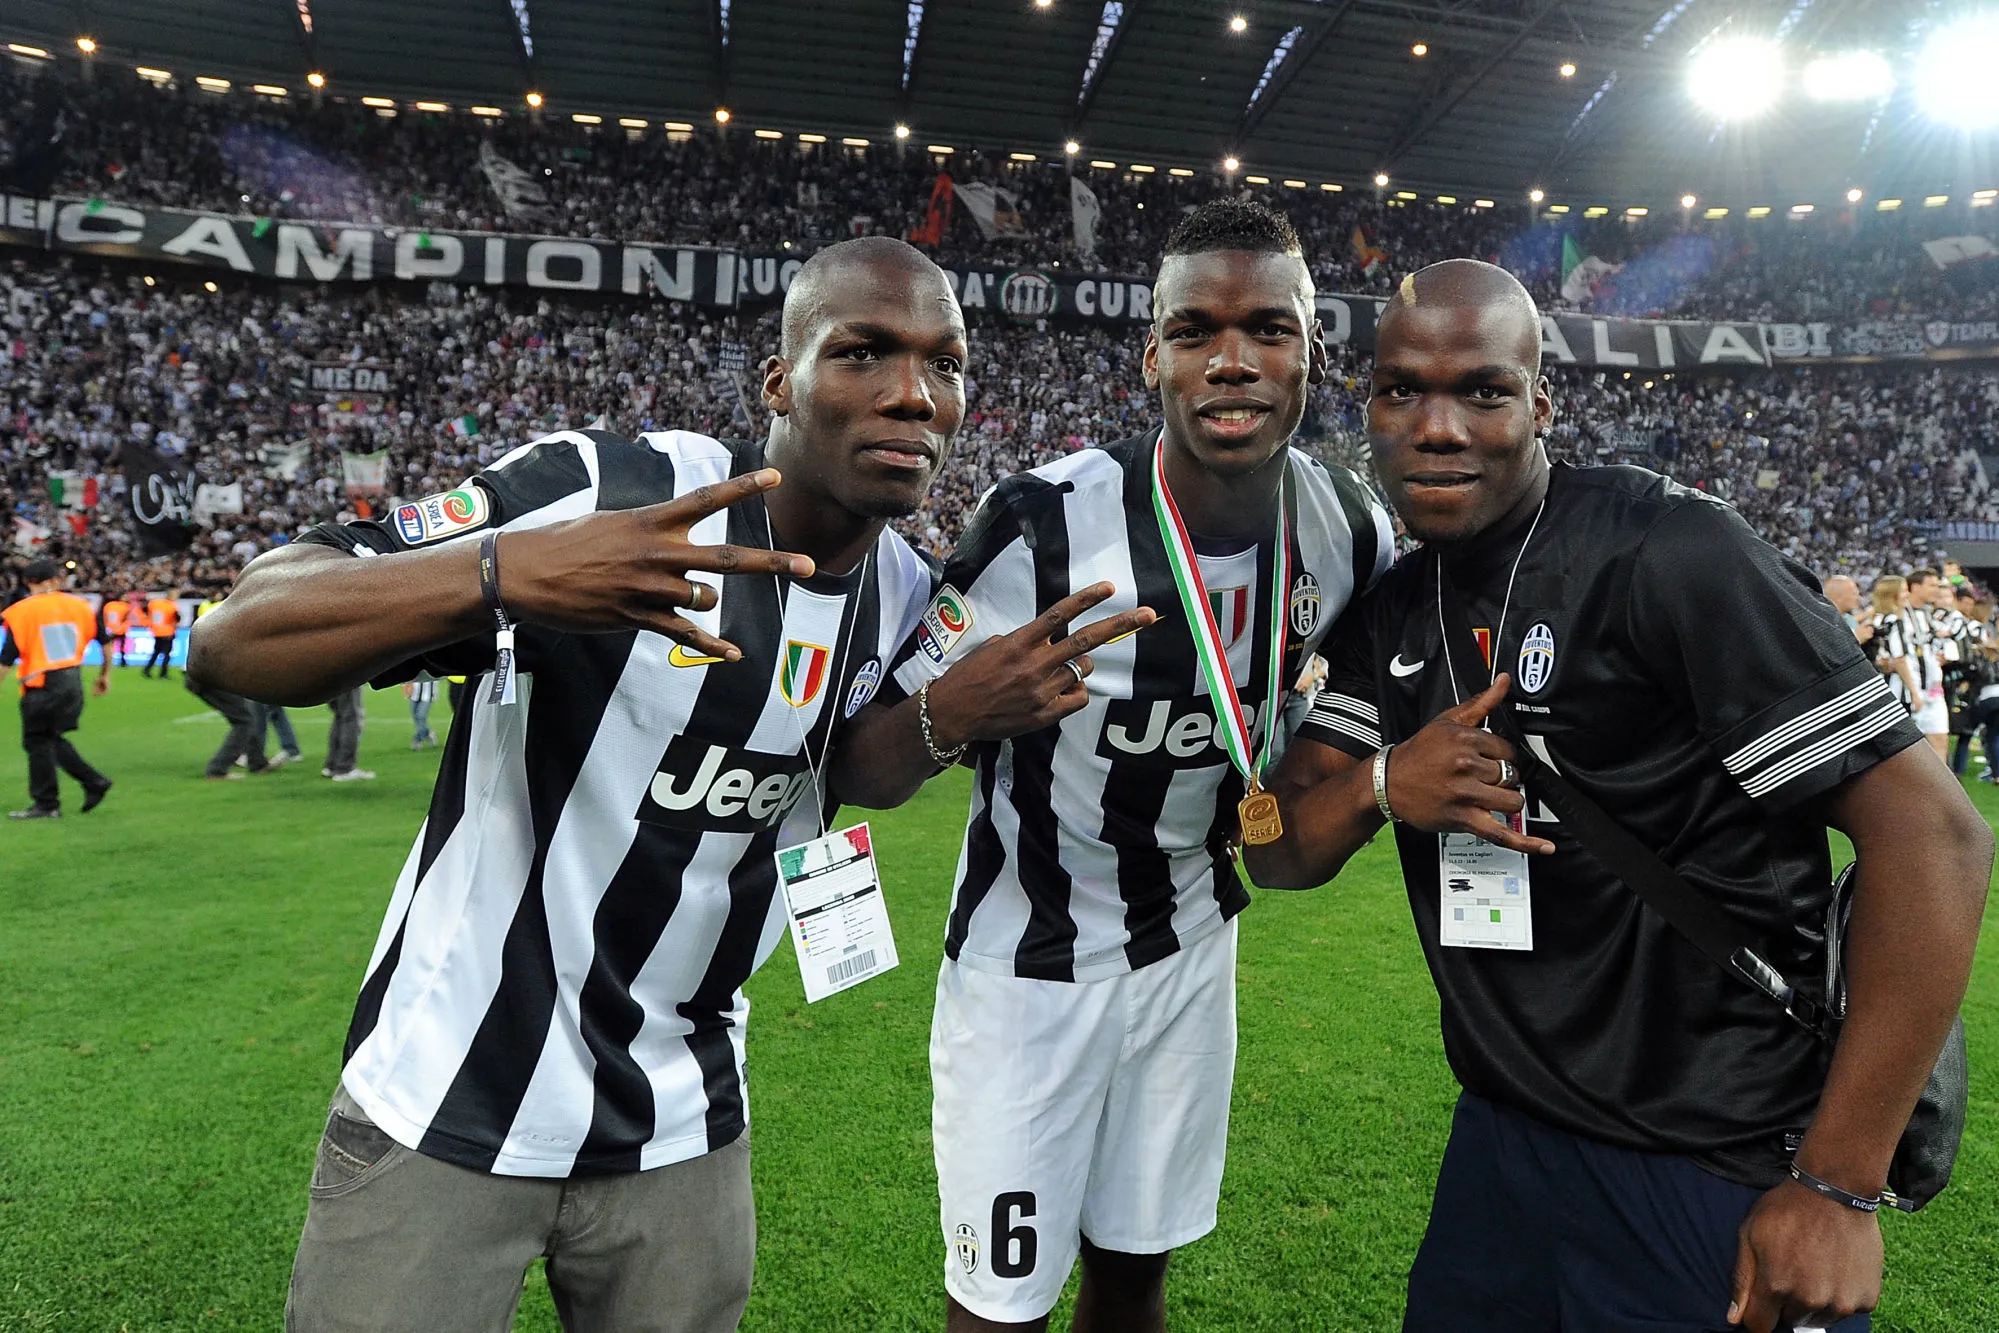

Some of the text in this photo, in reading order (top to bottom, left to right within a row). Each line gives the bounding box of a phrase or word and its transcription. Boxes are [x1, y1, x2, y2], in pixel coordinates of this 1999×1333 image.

[57, 203, 734, 304] CAMPIONI
[403, 518, 422, 538] TIM
[923, 636, 940, 659] TIM
[927, 611, 950, 644] SERIE A
[651, 745, 813, 827] Jeep
[991, 1191, 1037, 1278] 6
